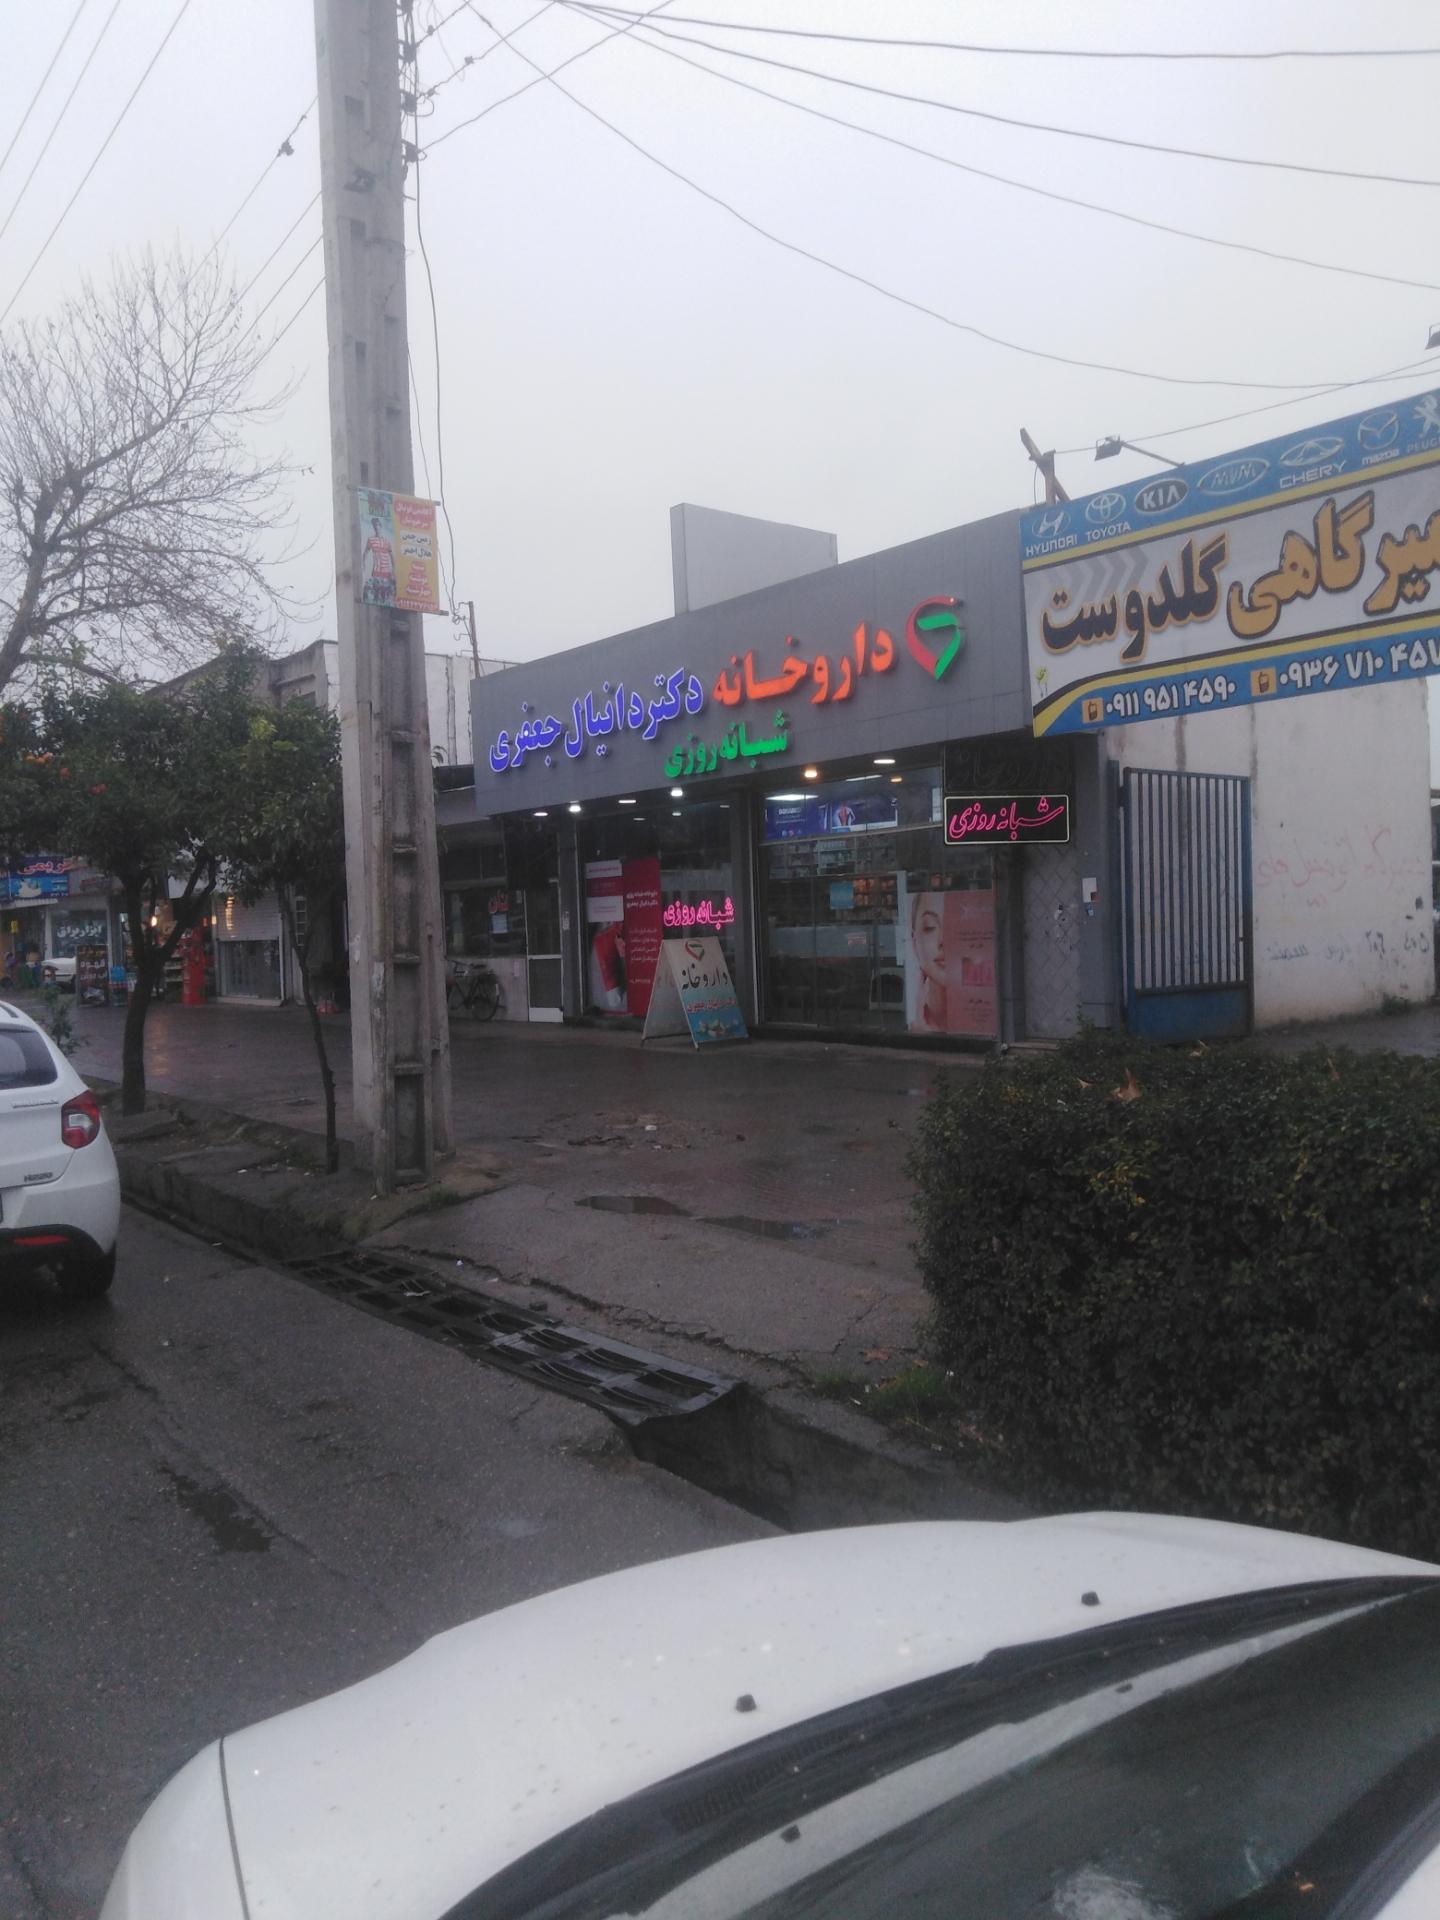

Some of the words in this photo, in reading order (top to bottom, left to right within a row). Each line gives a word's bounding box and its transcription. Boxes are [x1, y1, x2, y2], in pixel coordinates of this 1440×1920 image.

[1407, 436, 1440, 452] PEUG
[1280, 459, 1347, 488] CHERY
[1143, 485, 1180, 510] KIA
[1025, 534, 1078, 558] HYUNDAI
[1086, 522, 1132, 543] TOYOTA
[1040, 529, 1229, 663] گلدوست
[712, 619, 894, 707] داروخانه
[563, 681, 645, 760] دانیال
[641, 667, 704, 741] دکتر
[489, 701, 563, 774] جعفری
[663, 732, 718, 779] روزی
[718, 708, 789, 769] شبانه
[681, 963, 728, 990] داروخانه
